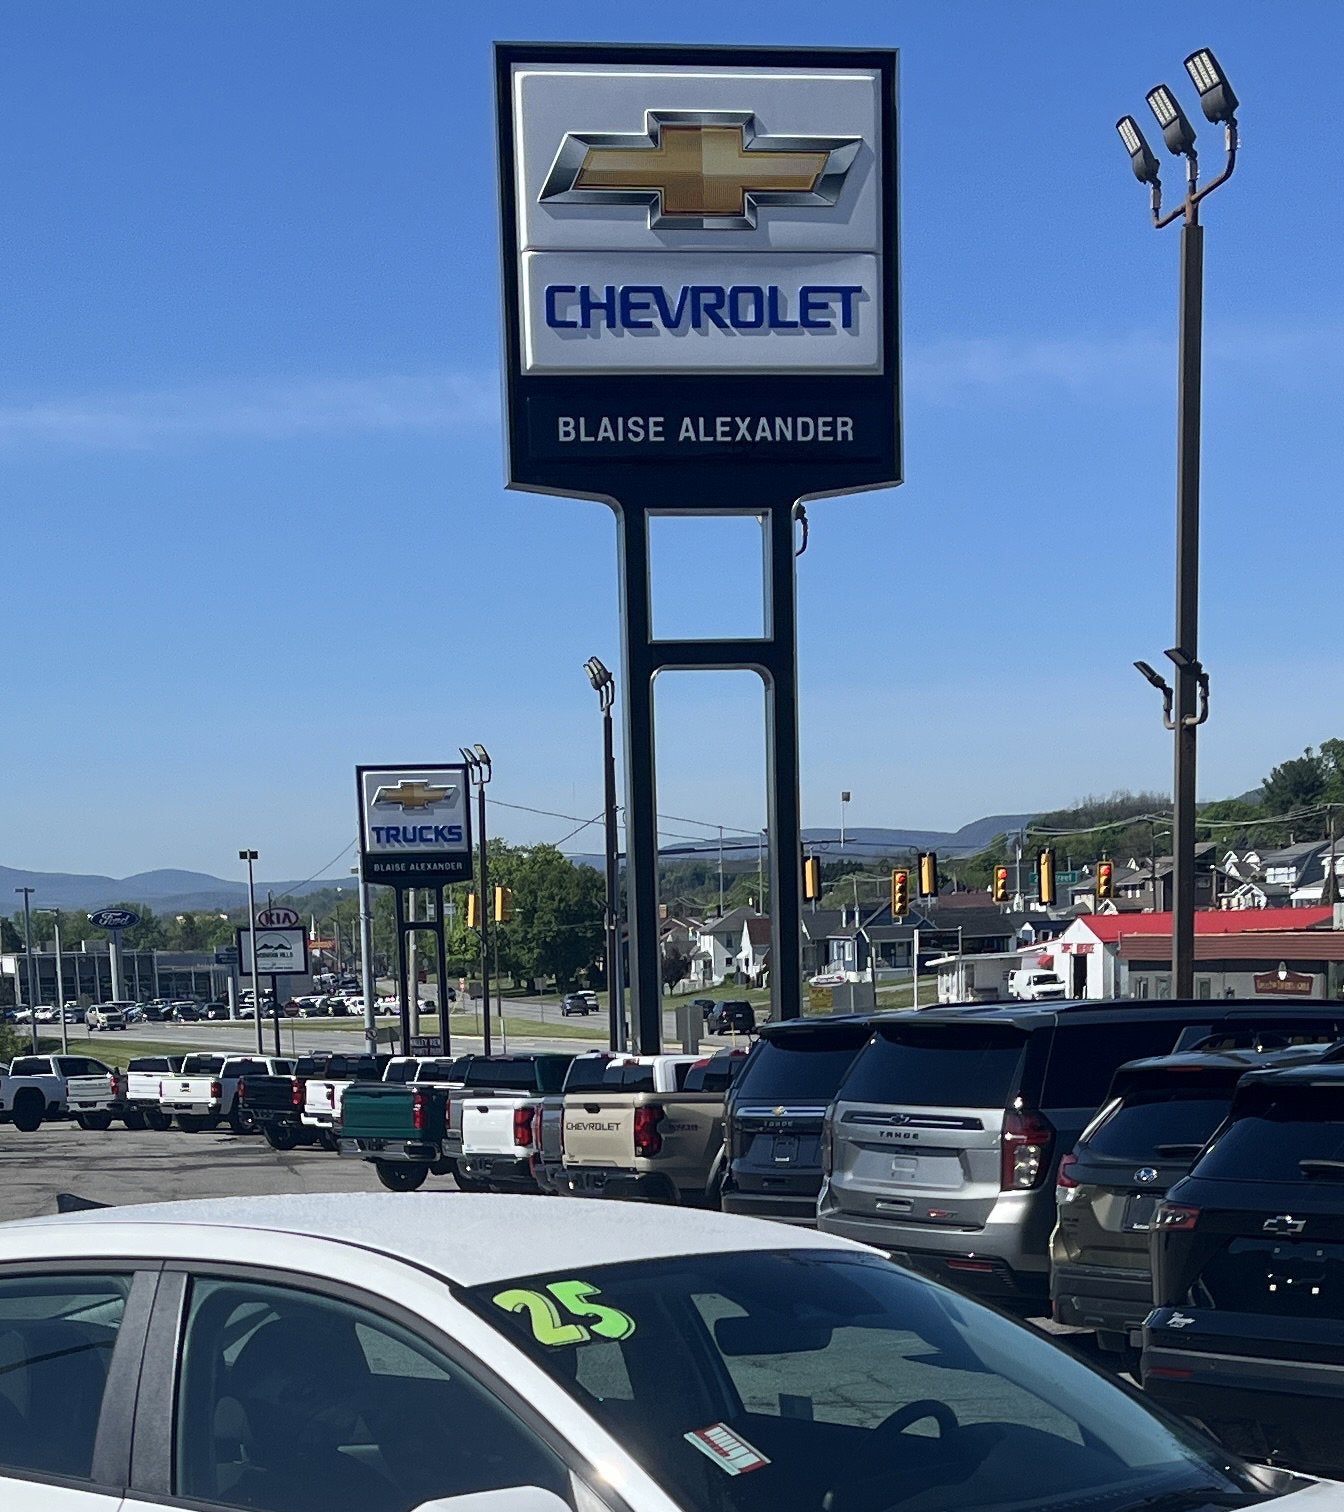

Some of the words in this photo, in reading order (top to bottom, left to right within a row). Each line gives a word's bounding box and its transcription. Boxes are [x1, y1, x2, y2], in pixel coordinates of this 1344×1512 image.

[545, 285, 862, 328] CHEVROLET
[558, 416, 665, 442] BLAISE
[678, 416, 854, 442] ALEXANDER
[371, 825, 463, 844] TRUCKS
[373, 863, 406, 872] BLAISE
[409, 861, 463, 871] ALEXANDER
[98, 912, 131, 926] Ford
[265, 912, 292, 925] KIA
[565, 1122, 621, 1131] CHEVROLET
[879, 1130, 919, 1140] TAHOE
[492, 1280, 636, 1346] 25
